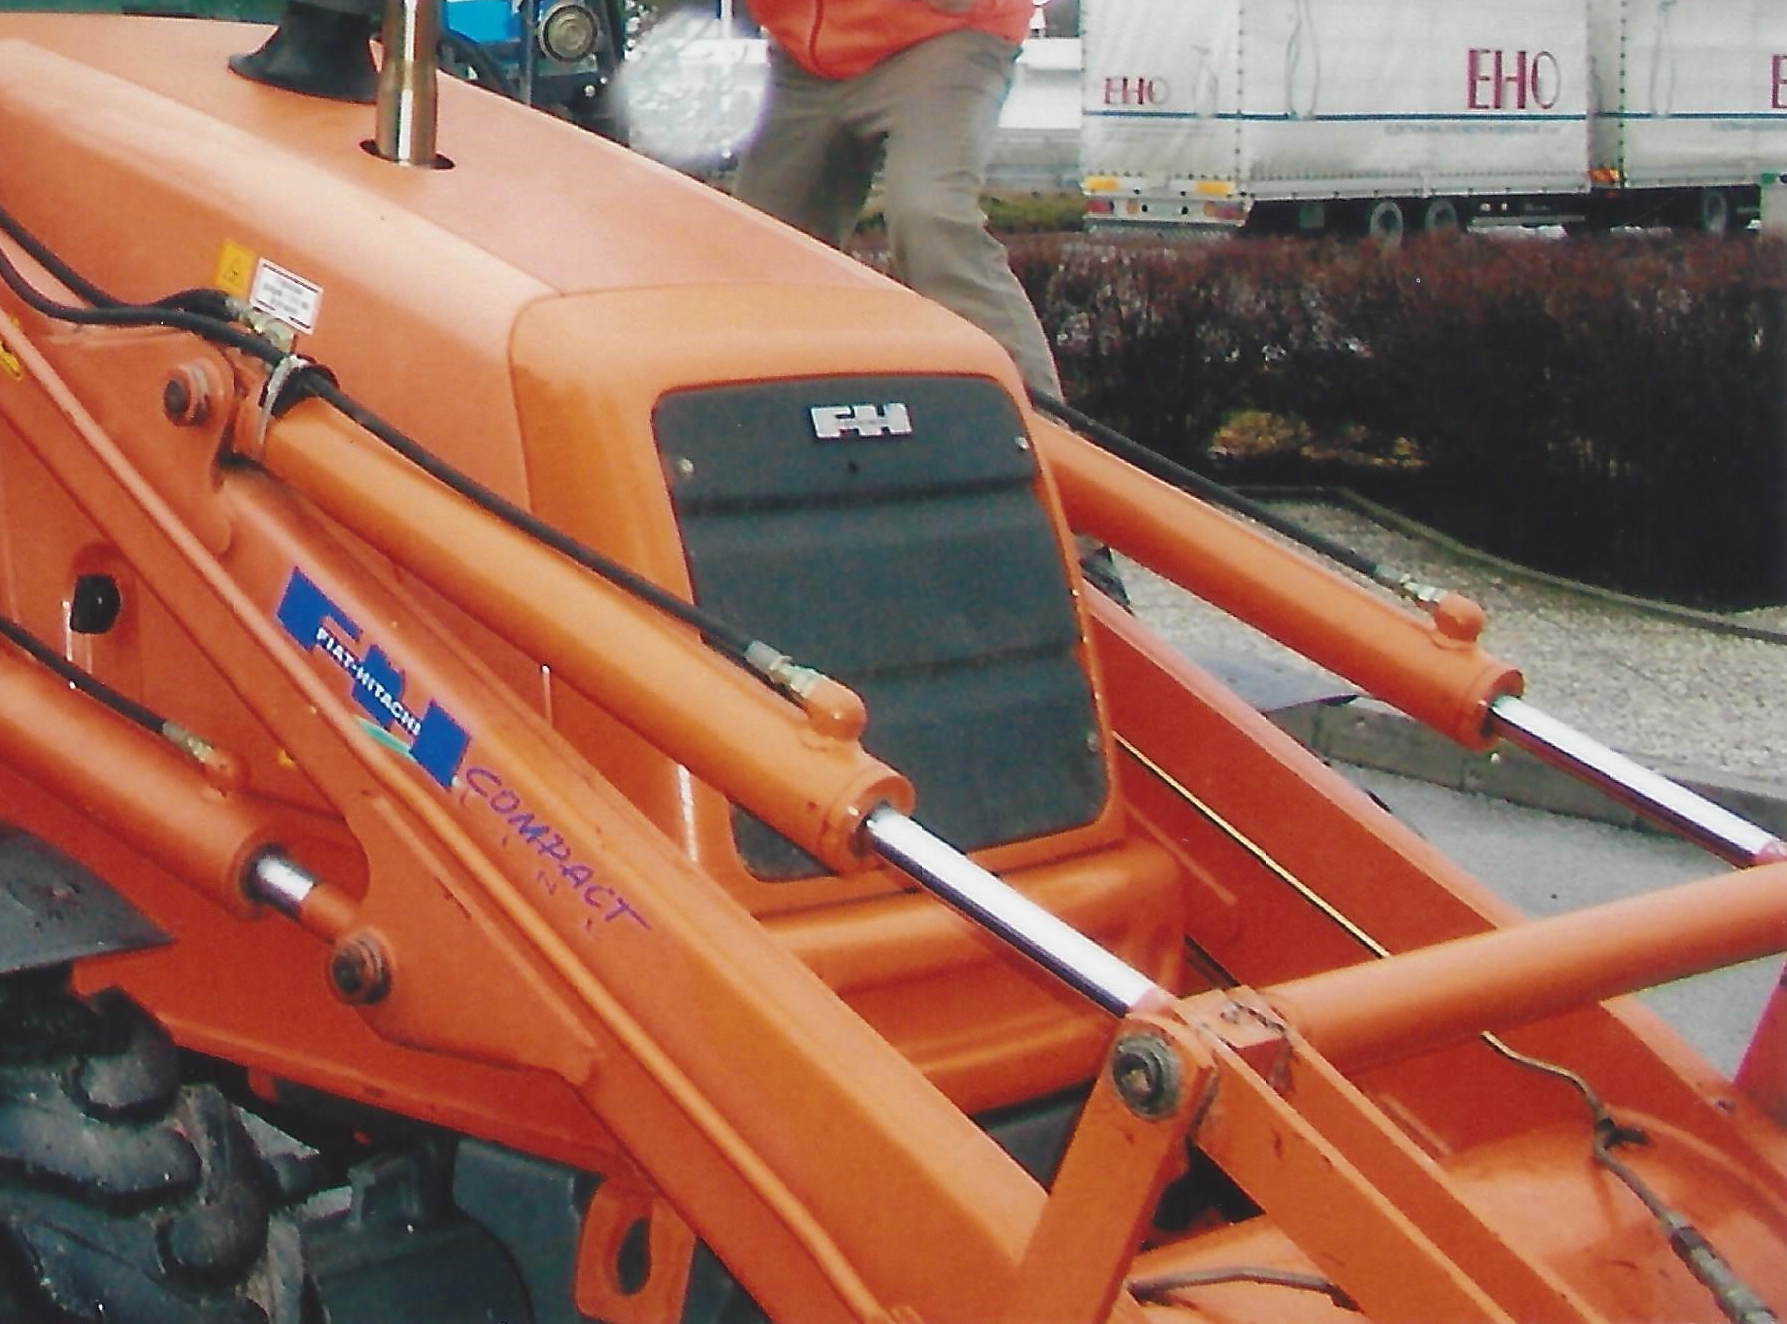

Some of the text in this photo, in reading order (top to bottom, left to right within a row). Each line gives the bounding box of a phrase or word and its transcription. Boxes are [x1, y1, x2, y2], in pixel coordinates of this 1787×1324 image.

[1104, 76, 1170, 106] EHO
[1467, 47, 1561, 110] EHO
[315, 626, 422, 736] FIAT-HITACHI
[465, 766, 652, 932] COMPACT
